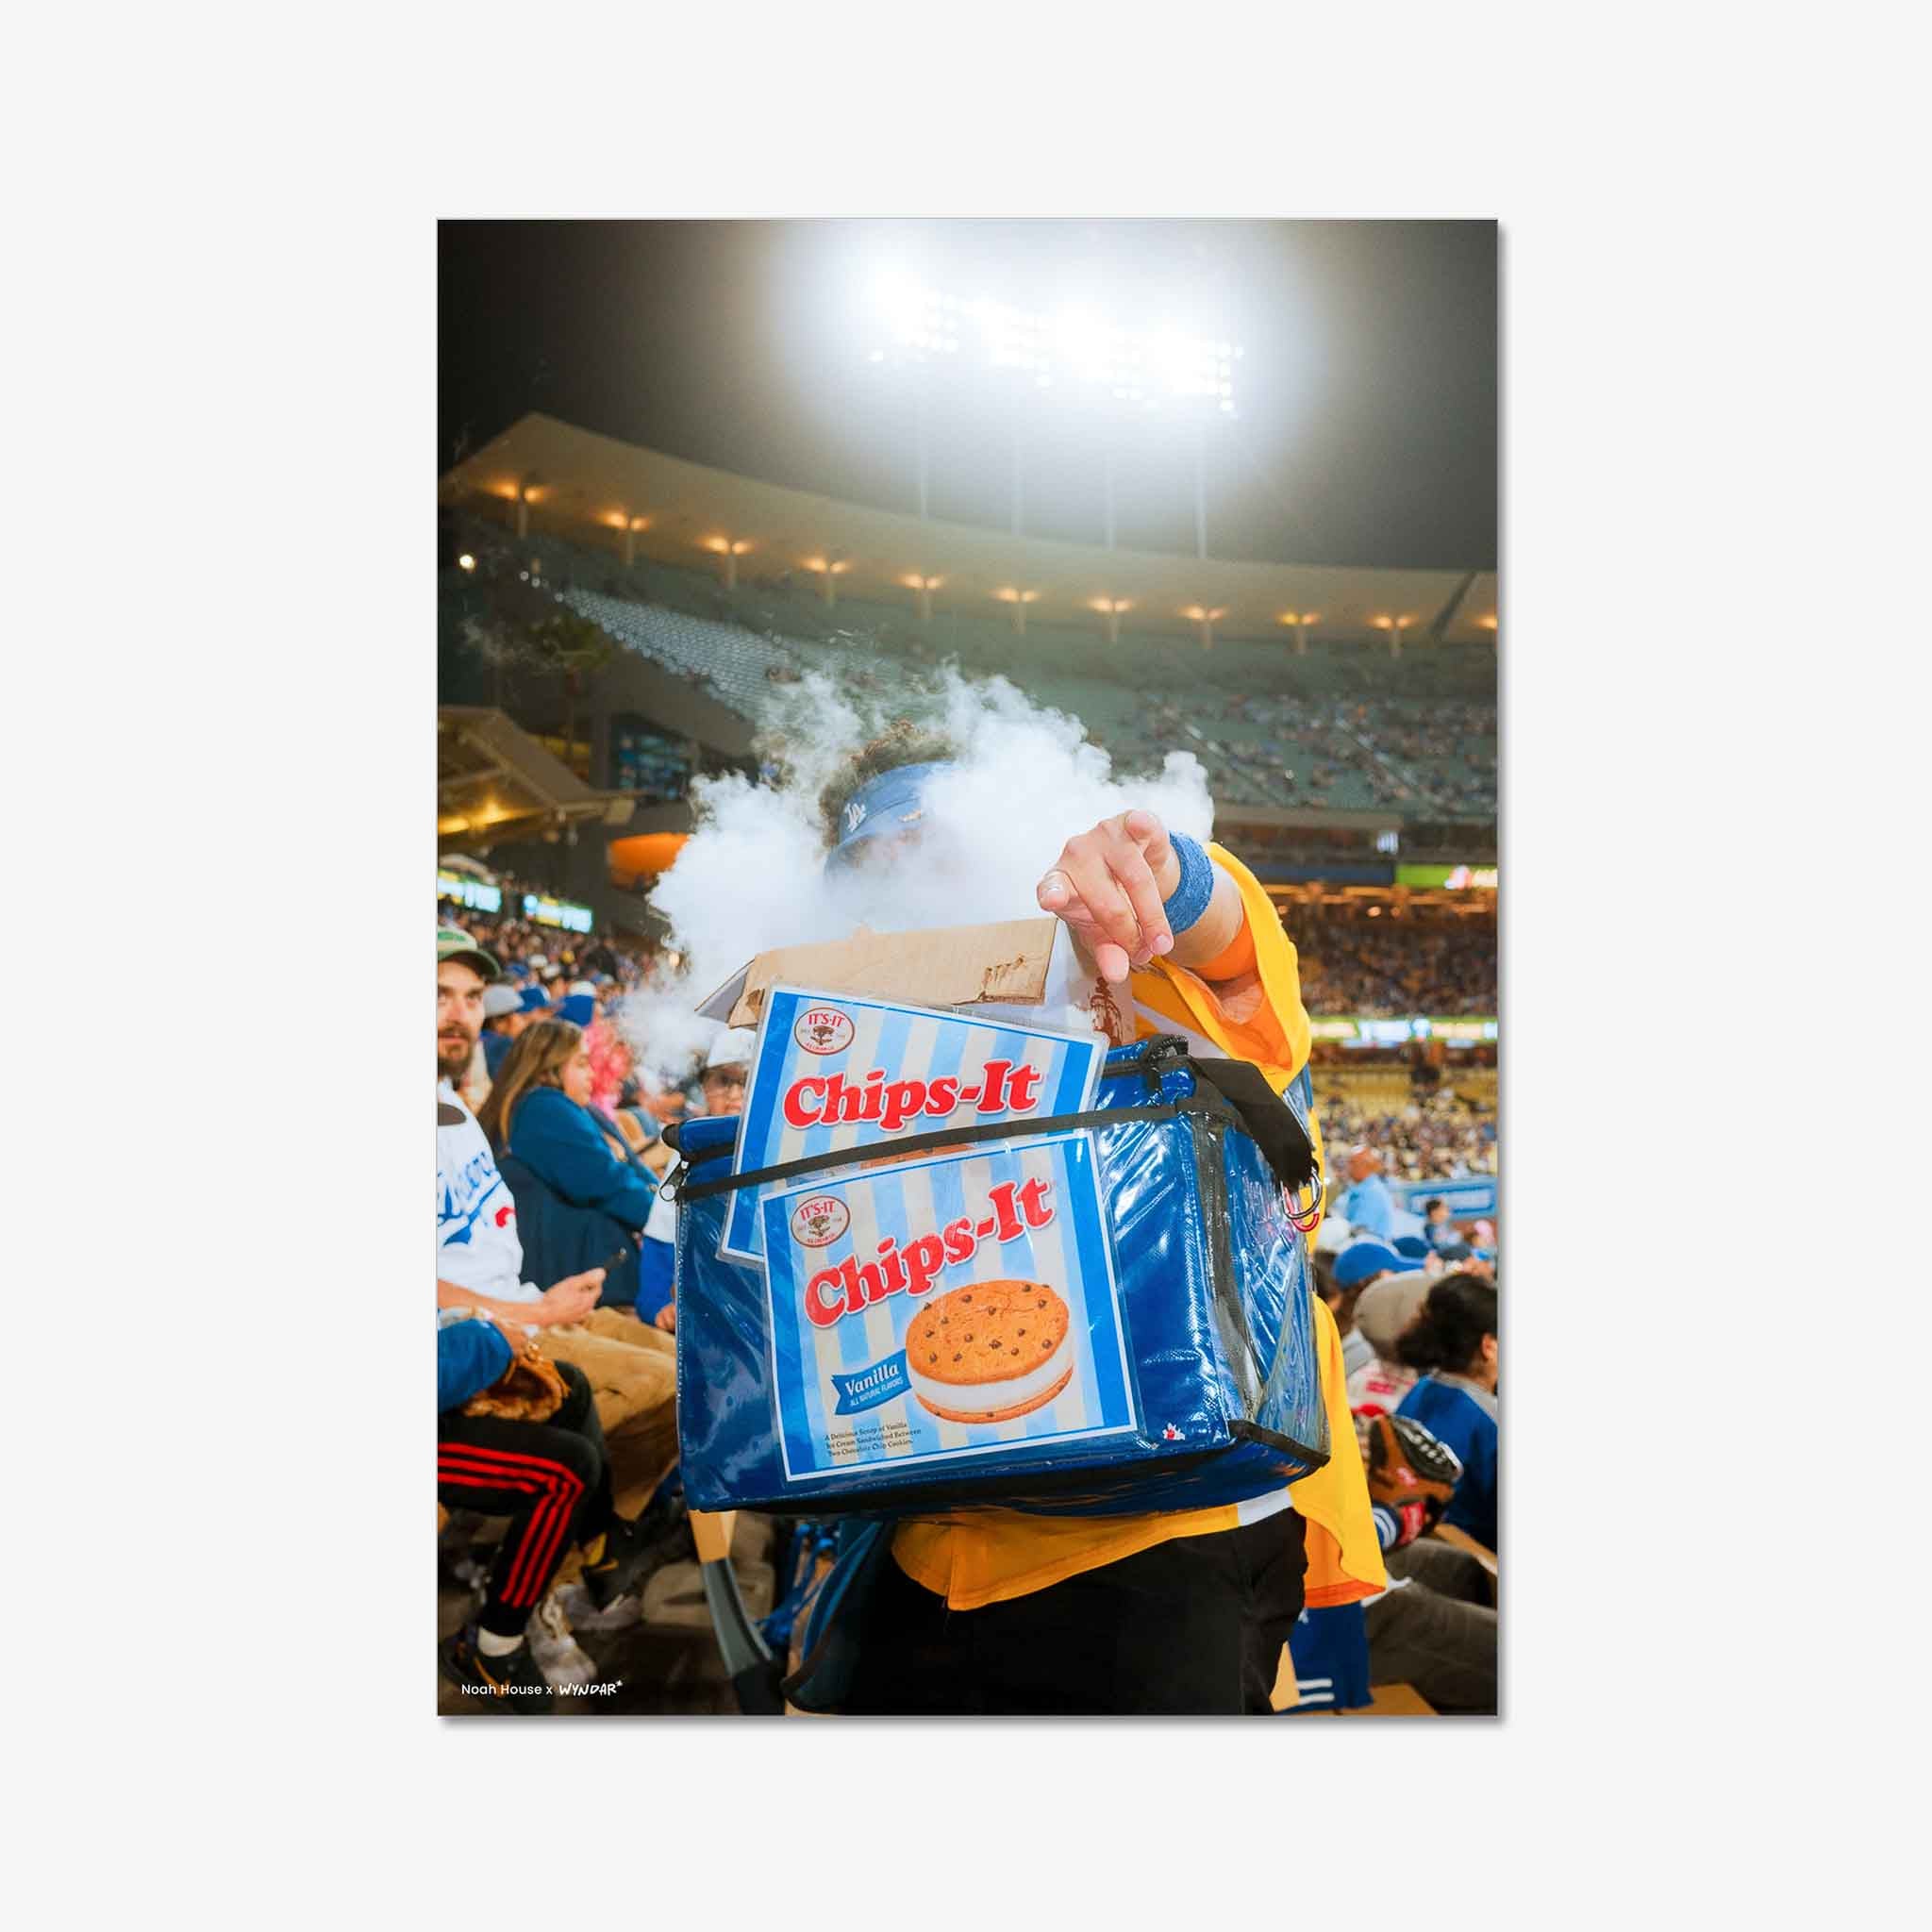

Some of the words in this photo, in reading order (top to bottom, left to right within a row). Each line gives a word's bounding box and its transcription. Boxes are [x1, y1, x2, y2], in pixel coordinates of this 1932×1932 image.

[783, 1060, 1041, 1131] Chips-It
[805, 1177, 1055, 1327] Chips-It
[845, 1364, 899, 1396] Vanilla
